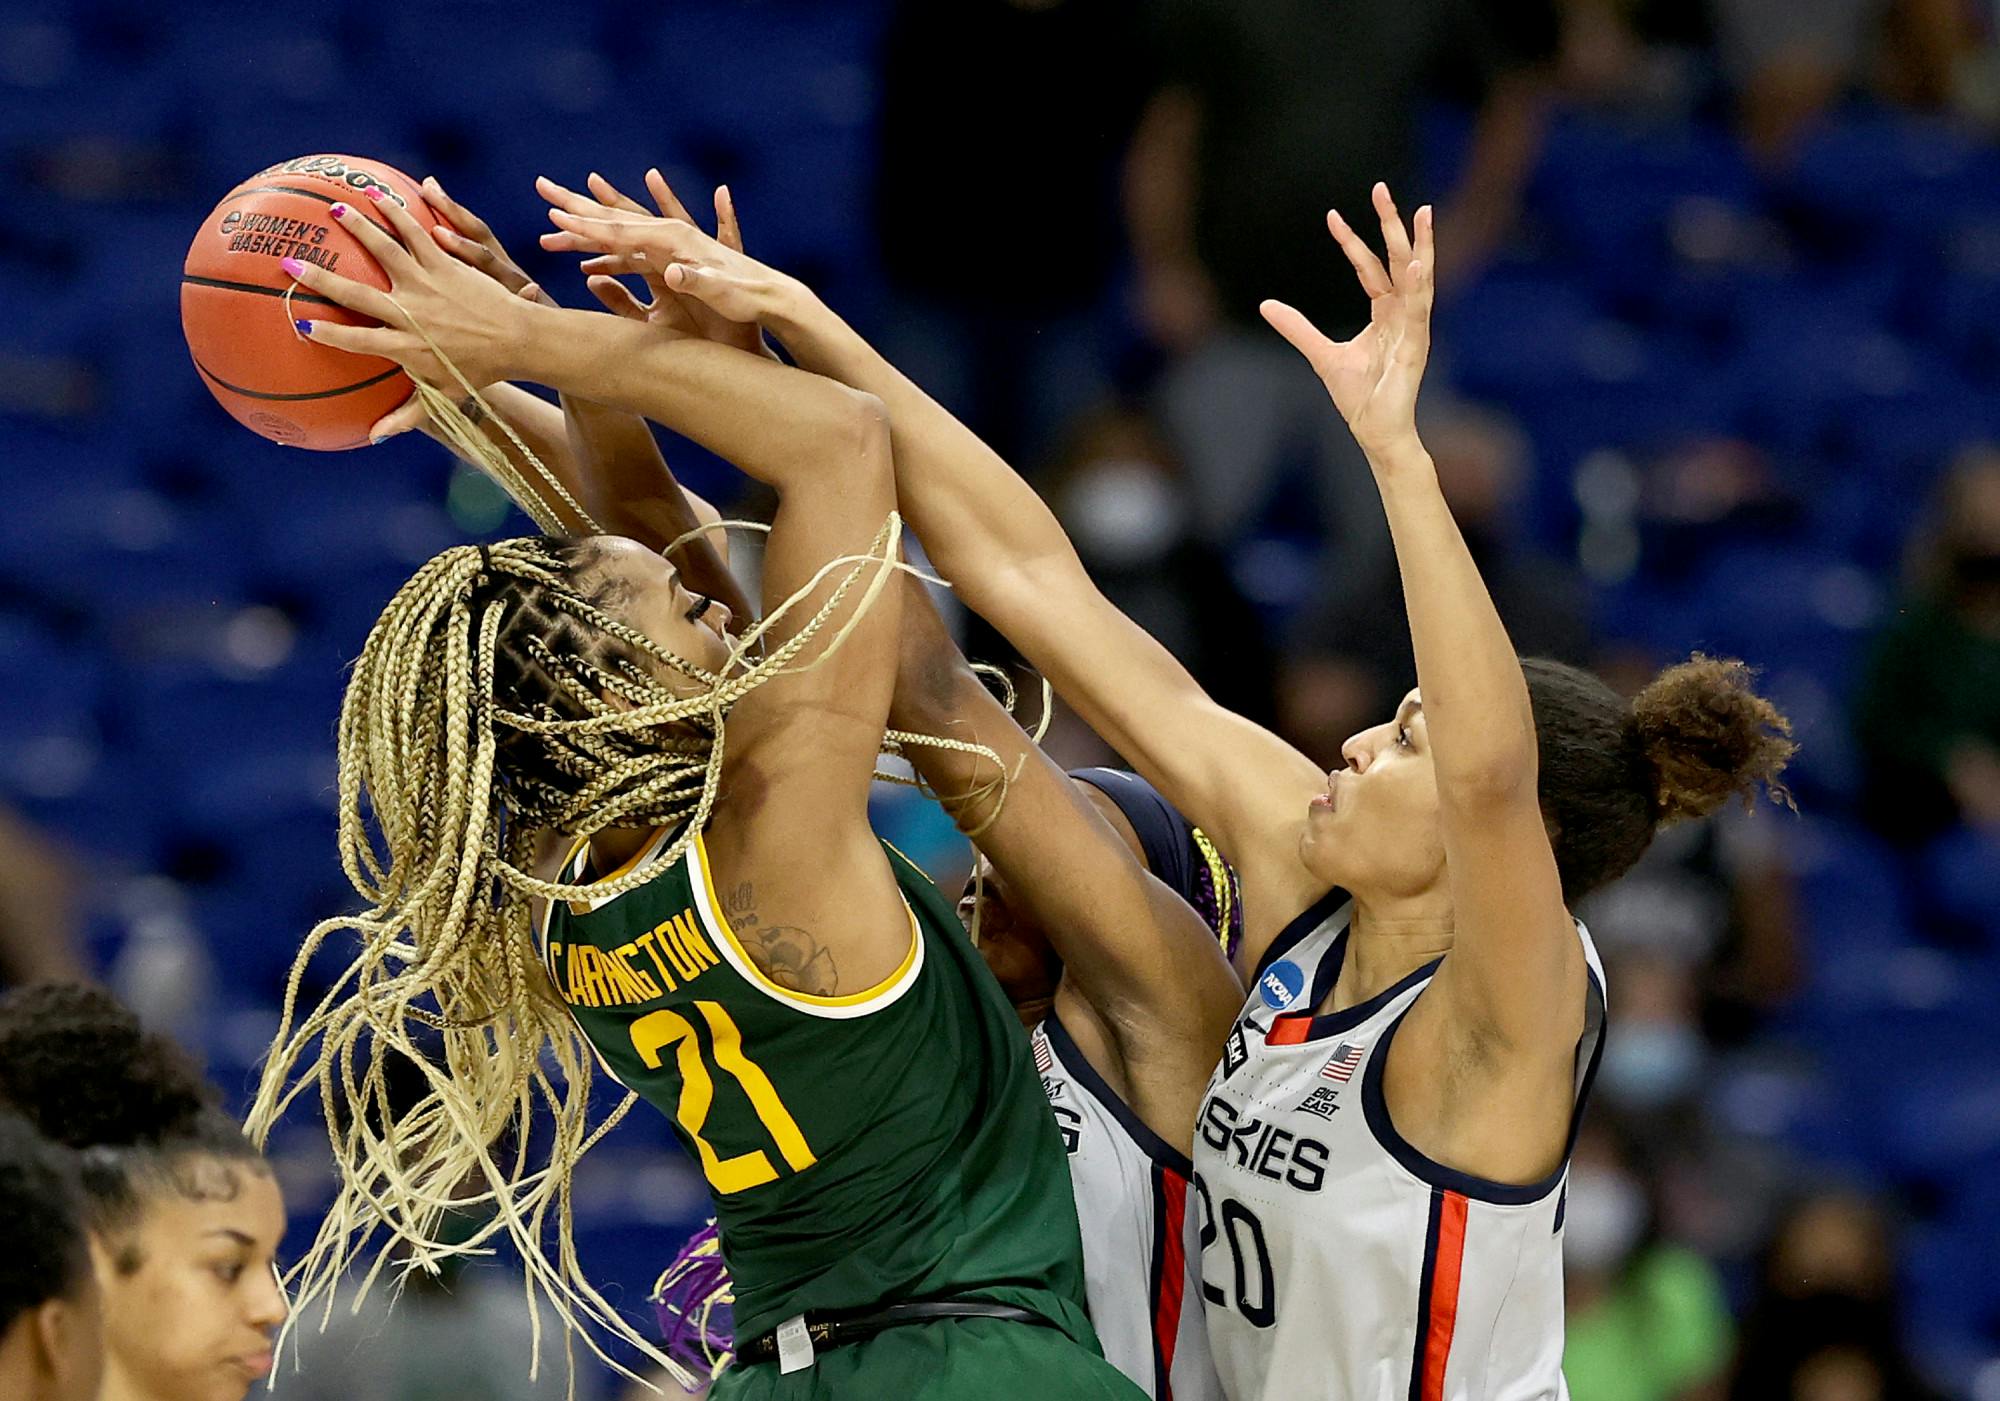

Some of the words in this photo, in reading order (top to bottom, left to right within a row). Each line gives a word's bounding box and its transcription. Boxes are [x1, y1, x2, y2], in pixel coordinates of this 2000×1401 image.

[242, 213, 328, 244] WOMEN'S
[229, 233, 339, 272] BASKETBALL
[1263, 972, 1294, 1007] NCAA
[1227, 1032, 1244, 1064] BLM
[629, 1000, 818, 1195] 21
[1301, 1097, 1340, 1117] EAST
[1312, 1087, 1339, 1102] BIG
[1194, 1171, 1275, 1328] 20
